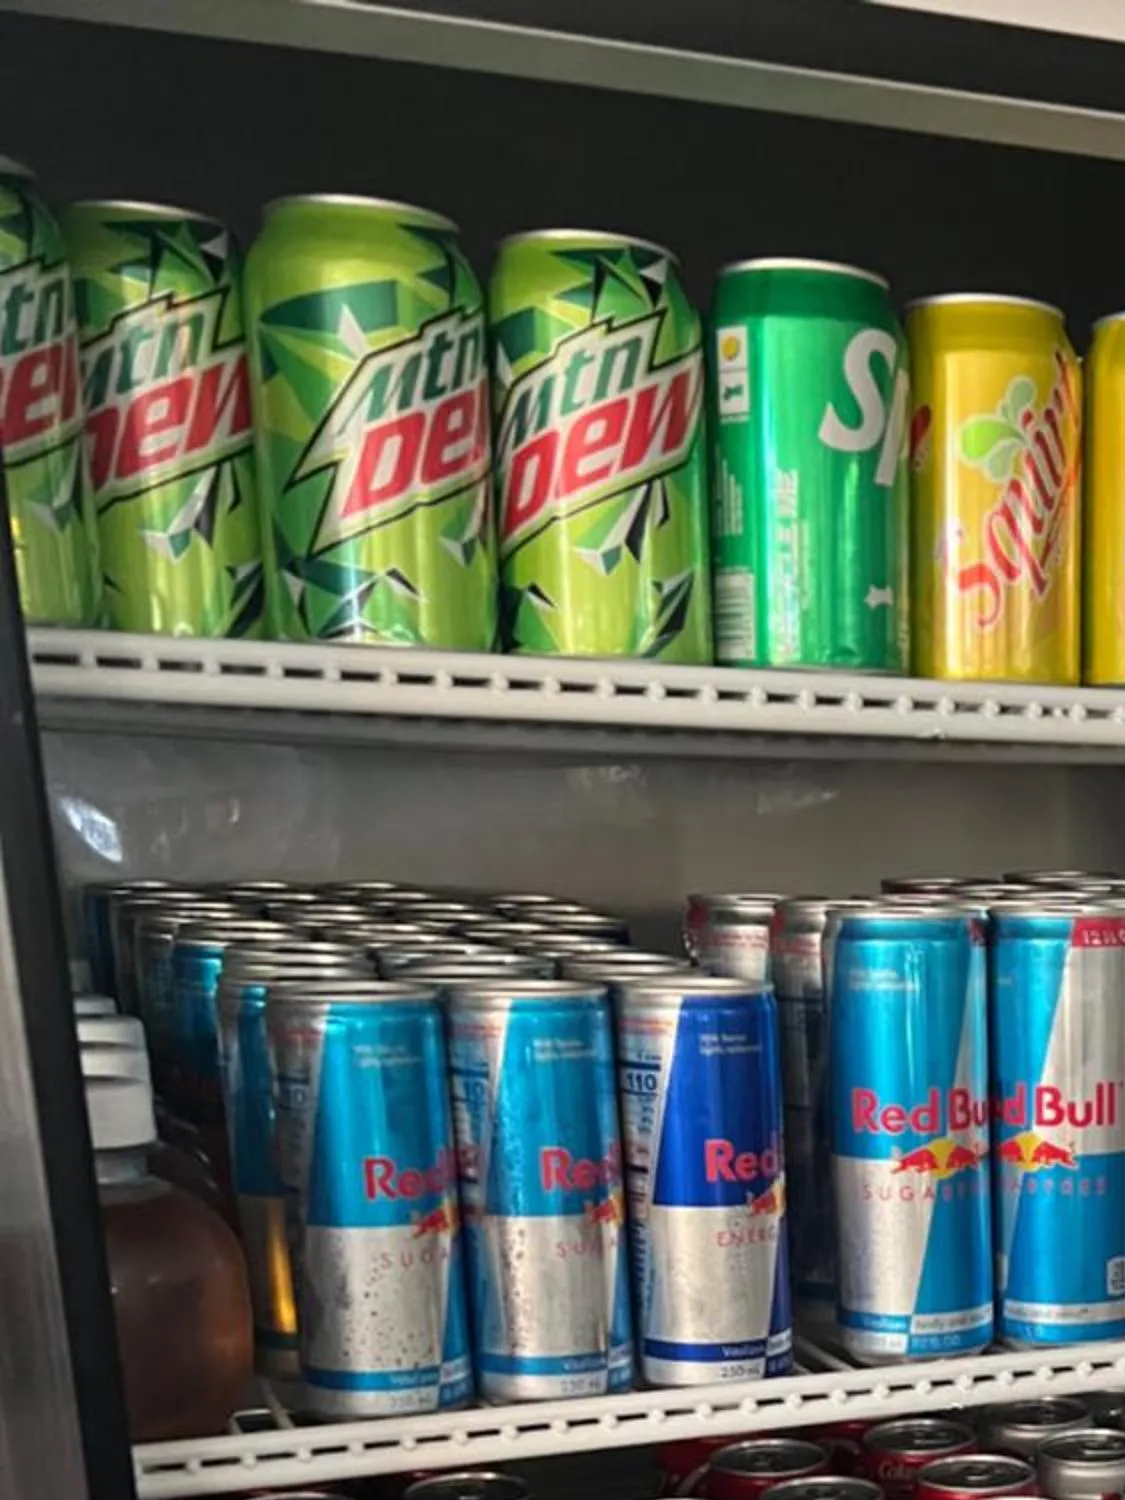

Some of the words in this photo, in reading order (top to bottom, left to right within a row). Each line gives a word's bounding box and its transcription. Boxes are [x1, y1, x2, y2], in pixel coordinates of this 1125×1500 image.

[502, 370, 692, 543] Dew
[625, 1073, 657, 1091] 110
[851, 1087, 941, 1133] Red
[1034, 1082, 1117, 1130] Bull
